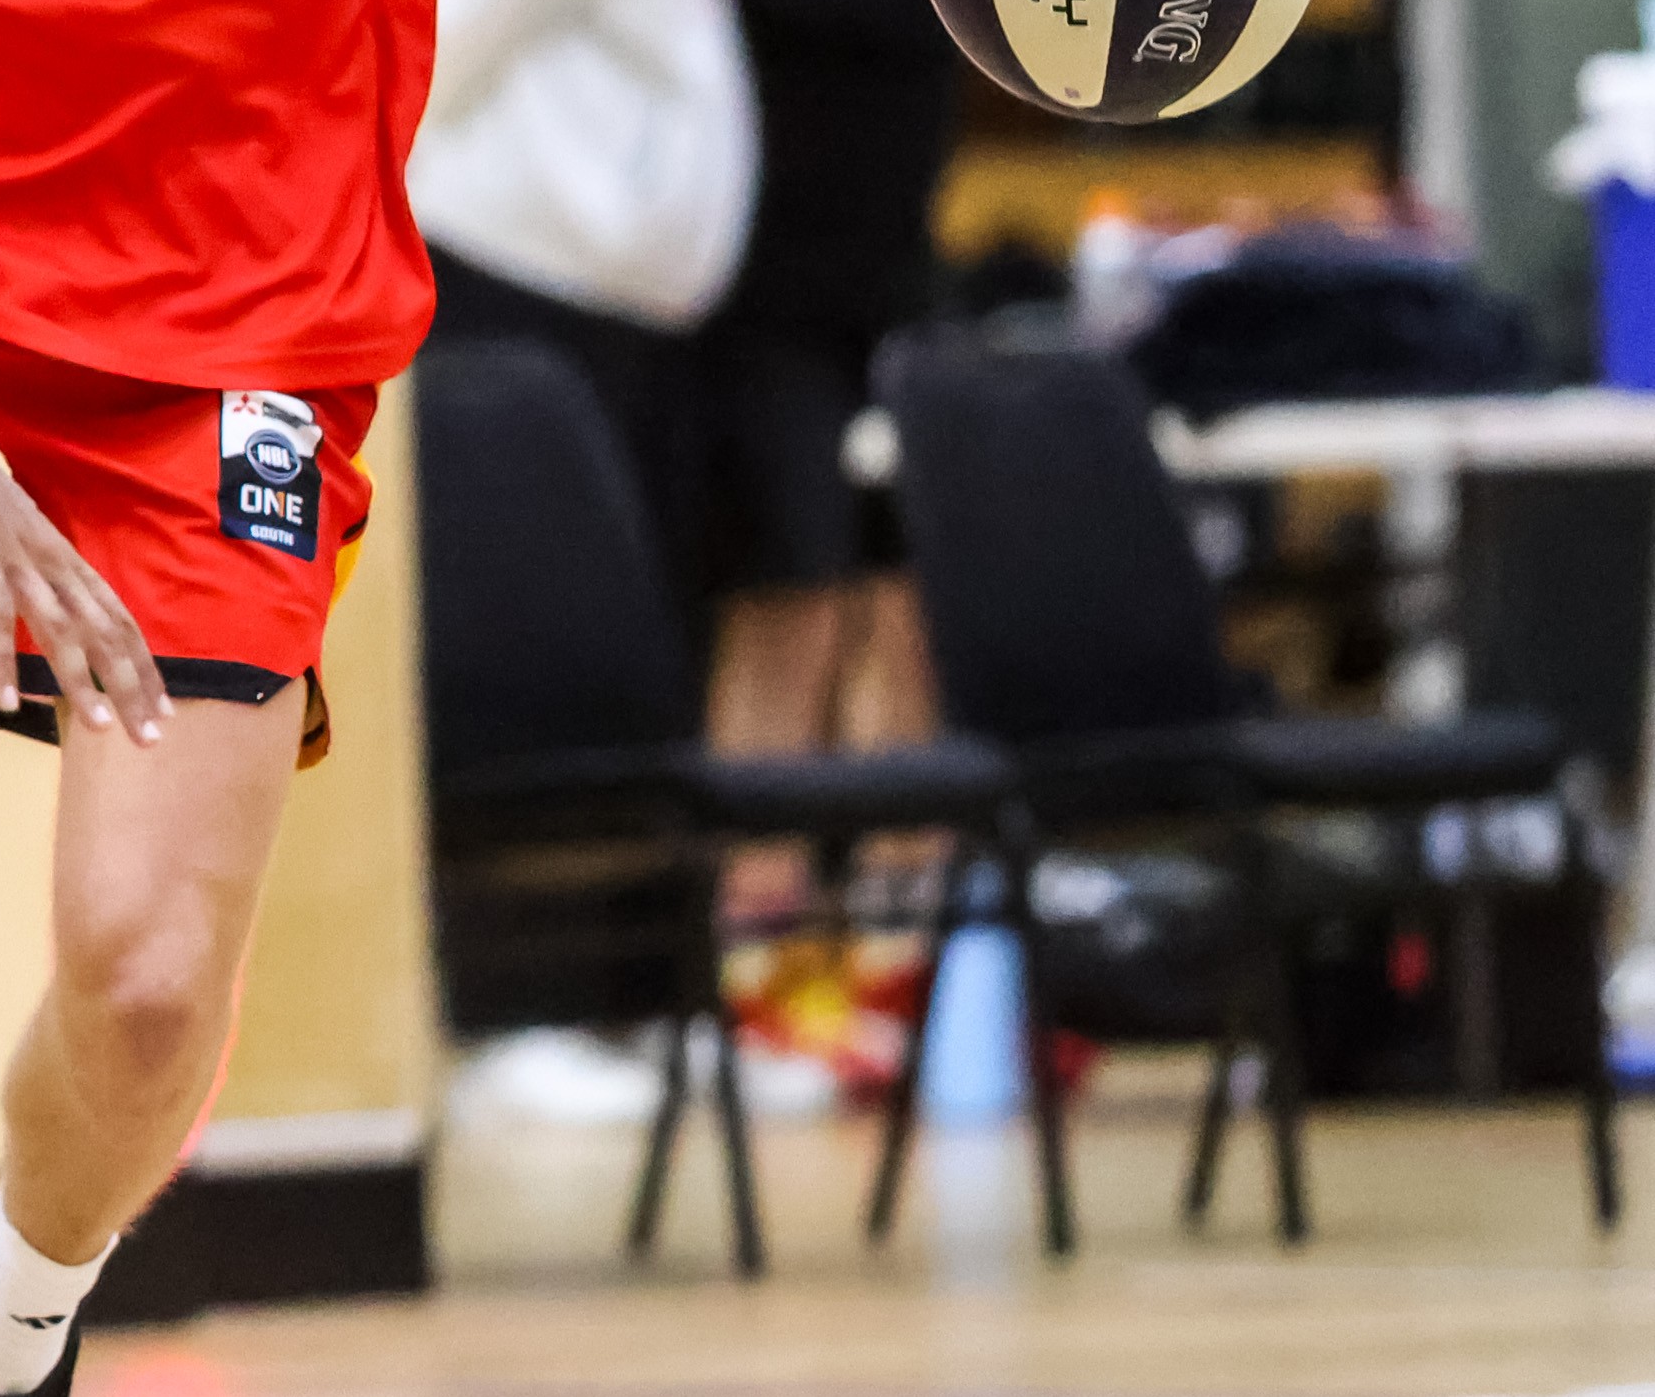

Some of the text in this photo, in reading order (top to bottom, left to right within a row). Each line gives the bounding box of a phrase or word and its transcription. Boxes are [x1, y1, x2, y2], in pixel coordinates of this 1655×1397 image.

[257, 443, 291, 470] NBL
[240, 483, 303, 525] ONE
[250, 524, 294, 546] SOUTH
